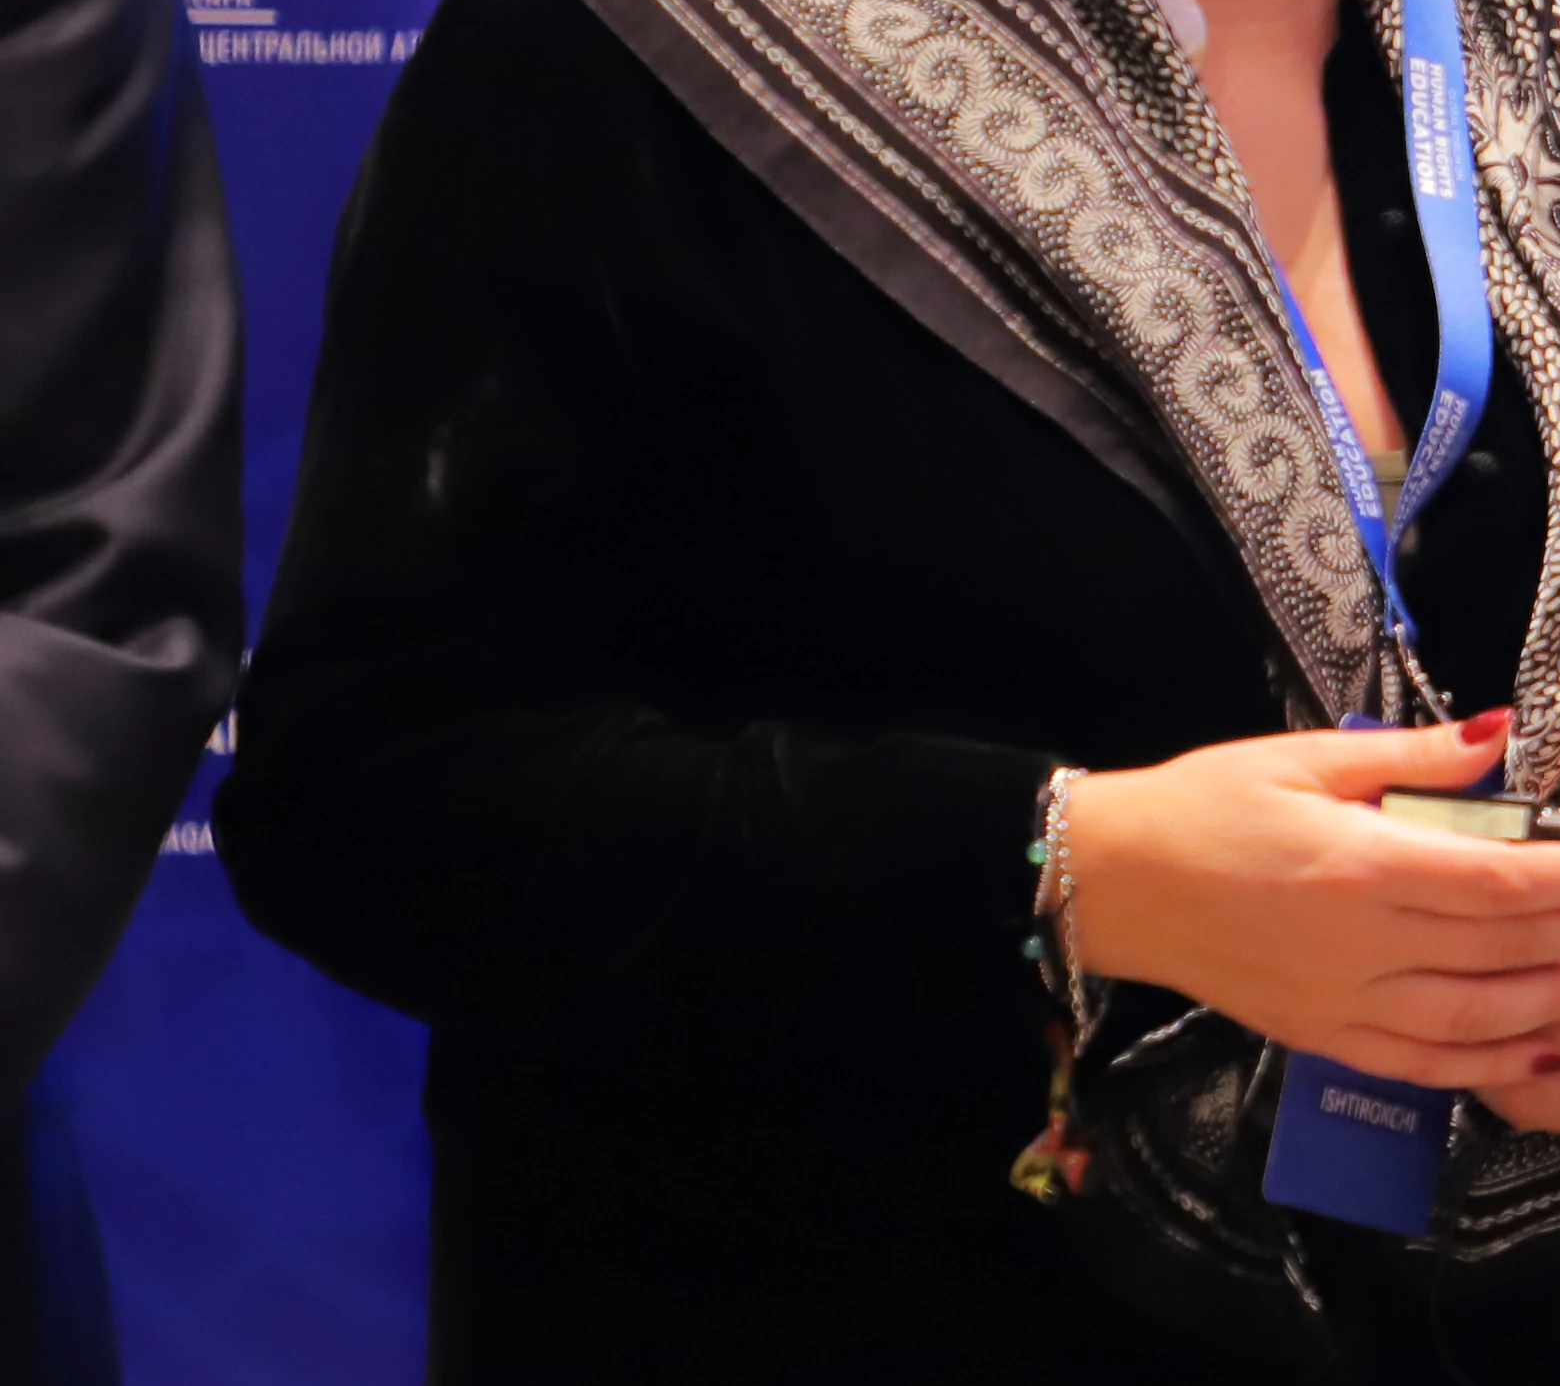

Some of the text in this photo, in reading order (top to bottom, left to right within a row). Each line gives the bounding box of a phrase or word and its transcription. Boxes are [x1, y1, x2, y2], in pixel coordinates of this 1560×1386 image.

[200, 28, 382, 67] ЦЕНТРАЛЬНОЙ
[1409, 57, 1437, 195] EDUCATION
[1429, 62, 1454, 199] HUMAN RIGHTS
[1309, 368, 1381, 518] EDUCATION
